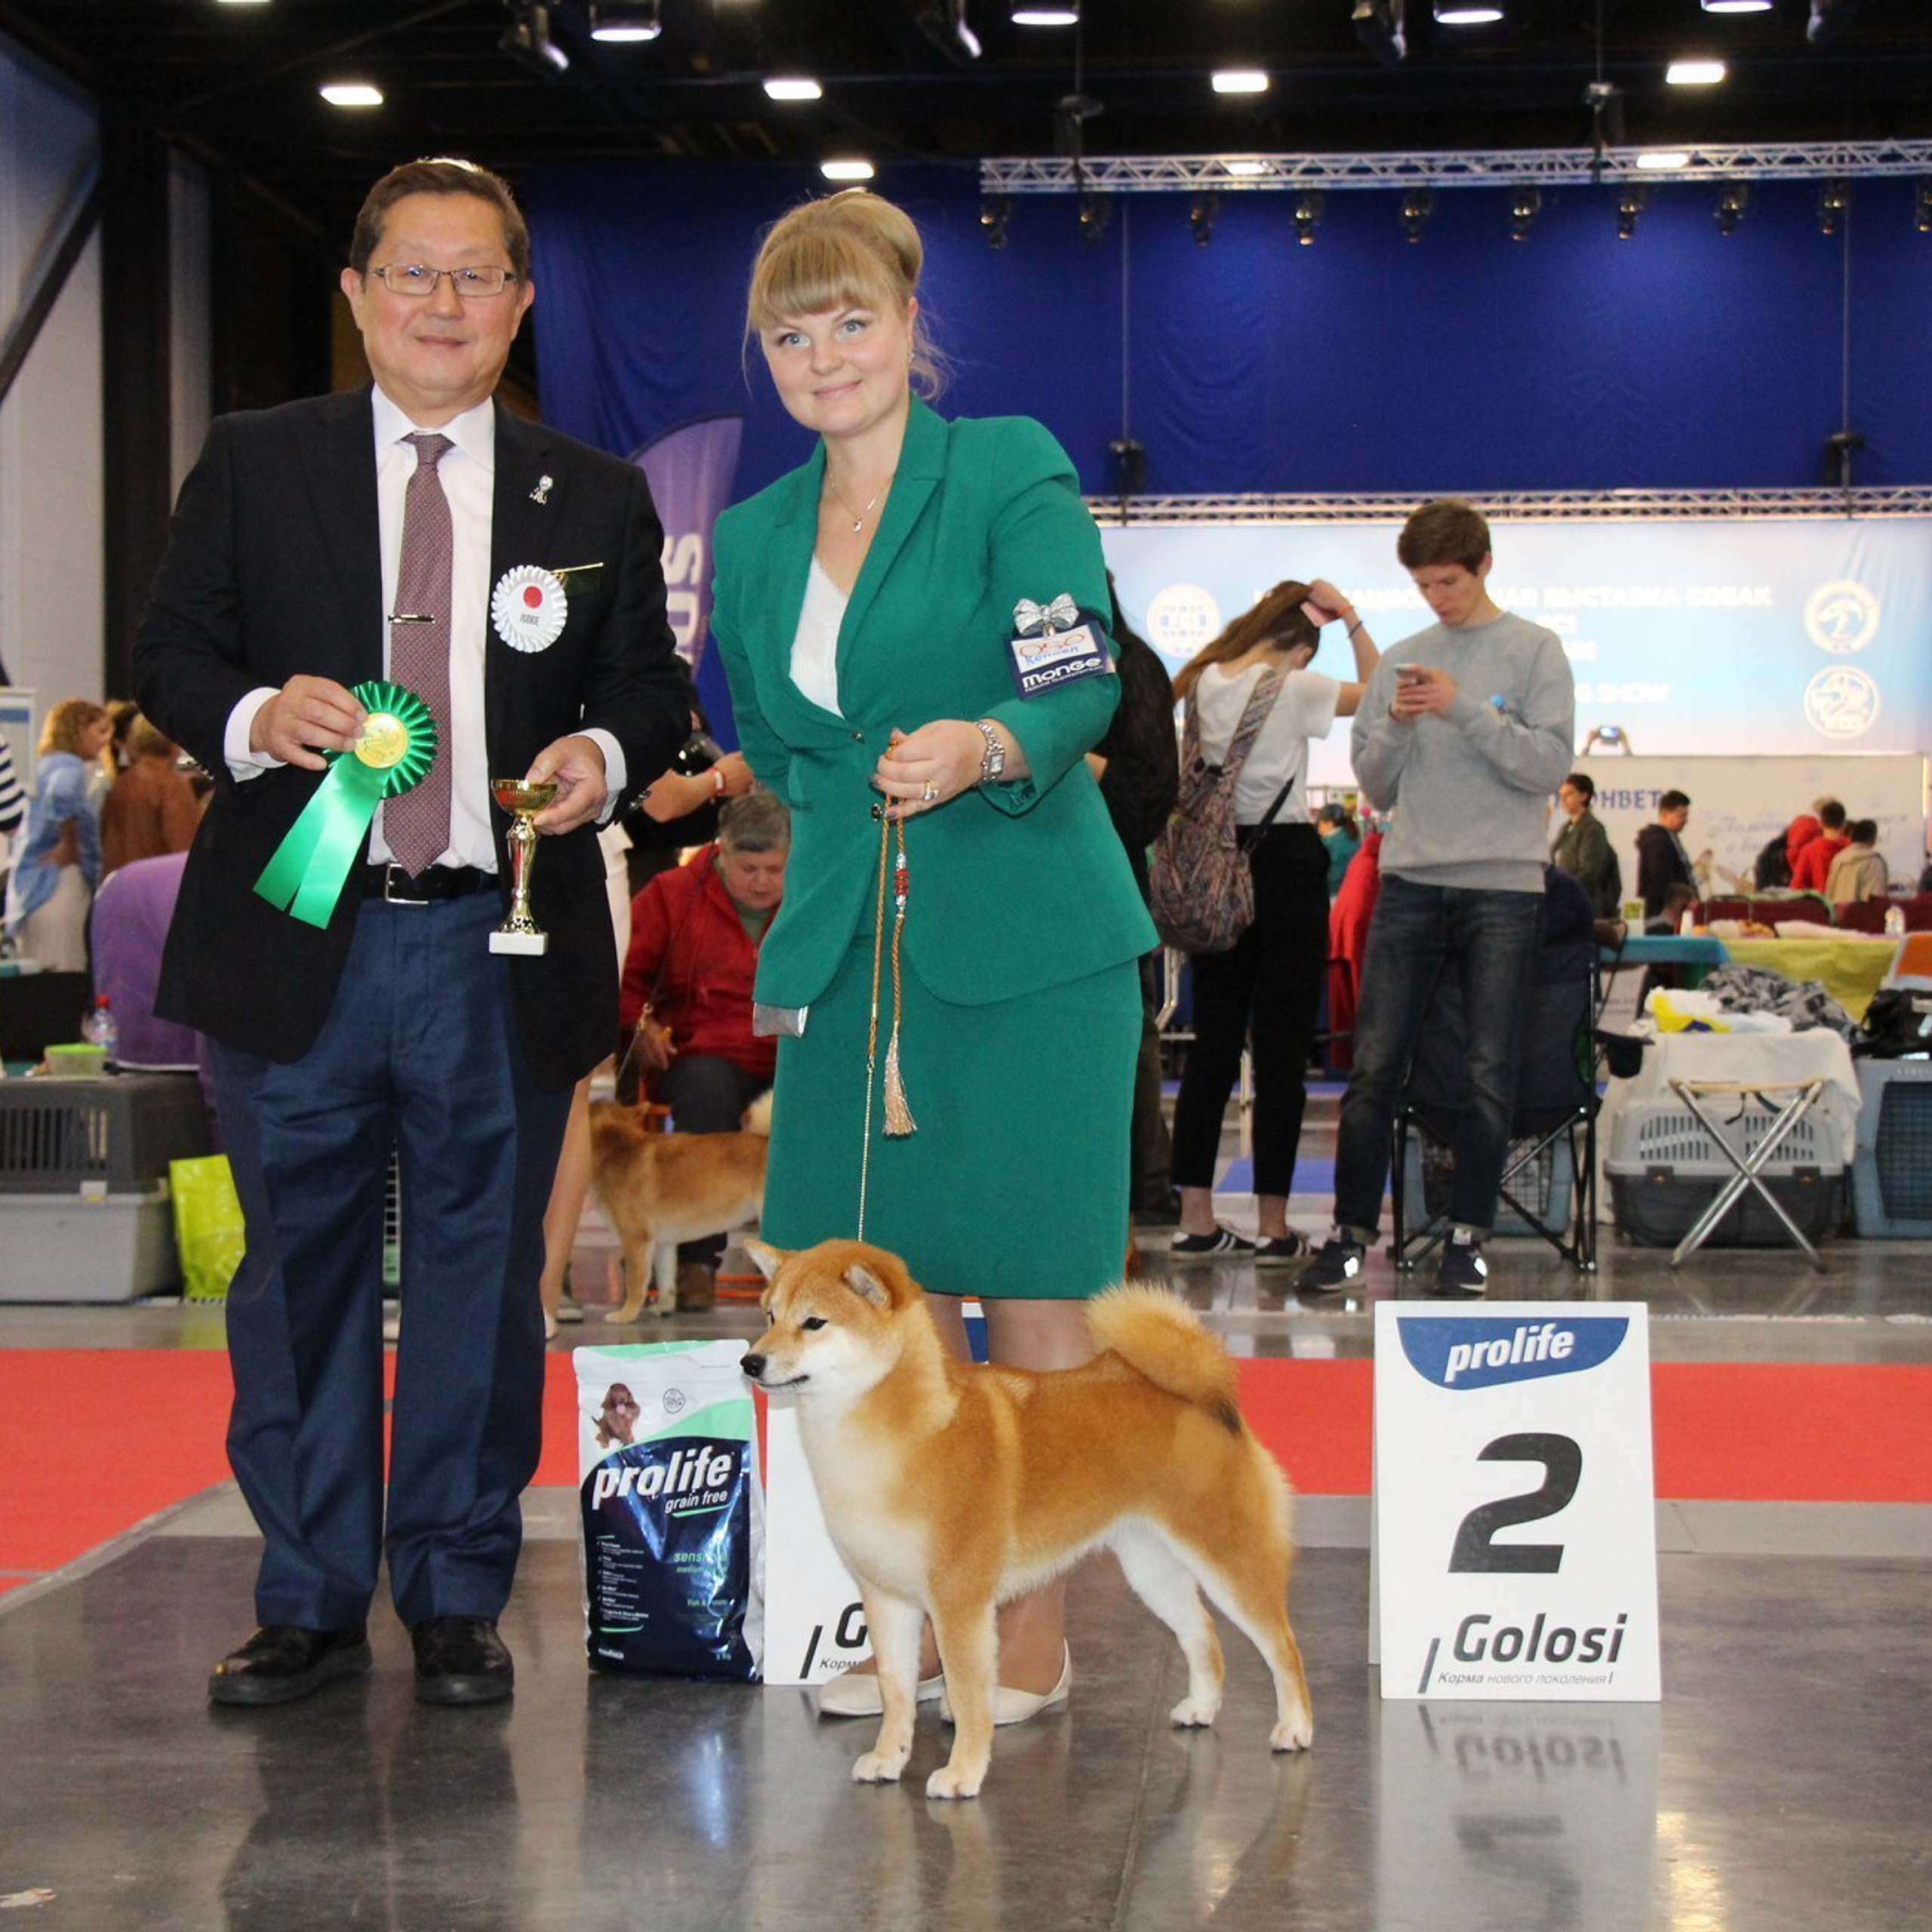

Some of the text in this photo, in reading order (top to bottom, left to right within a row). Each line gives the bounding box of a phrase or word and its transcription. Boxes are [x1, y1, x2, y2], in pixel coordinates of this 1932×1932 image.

[1444, 1323, 1575, 1382] prolife
[592, 1446, 732, 1510] prolife
[666, 1490, 728, 1514] grain free
[1448, 1432, 1583, 1573] 2
[1453, 1612, 1628, 1663] Golosi
[820, 1658, 857, 1670] Корм
[1438, 1672, 1483, 1684] Корма
[1487, 1673, 1534, 1684] нового
